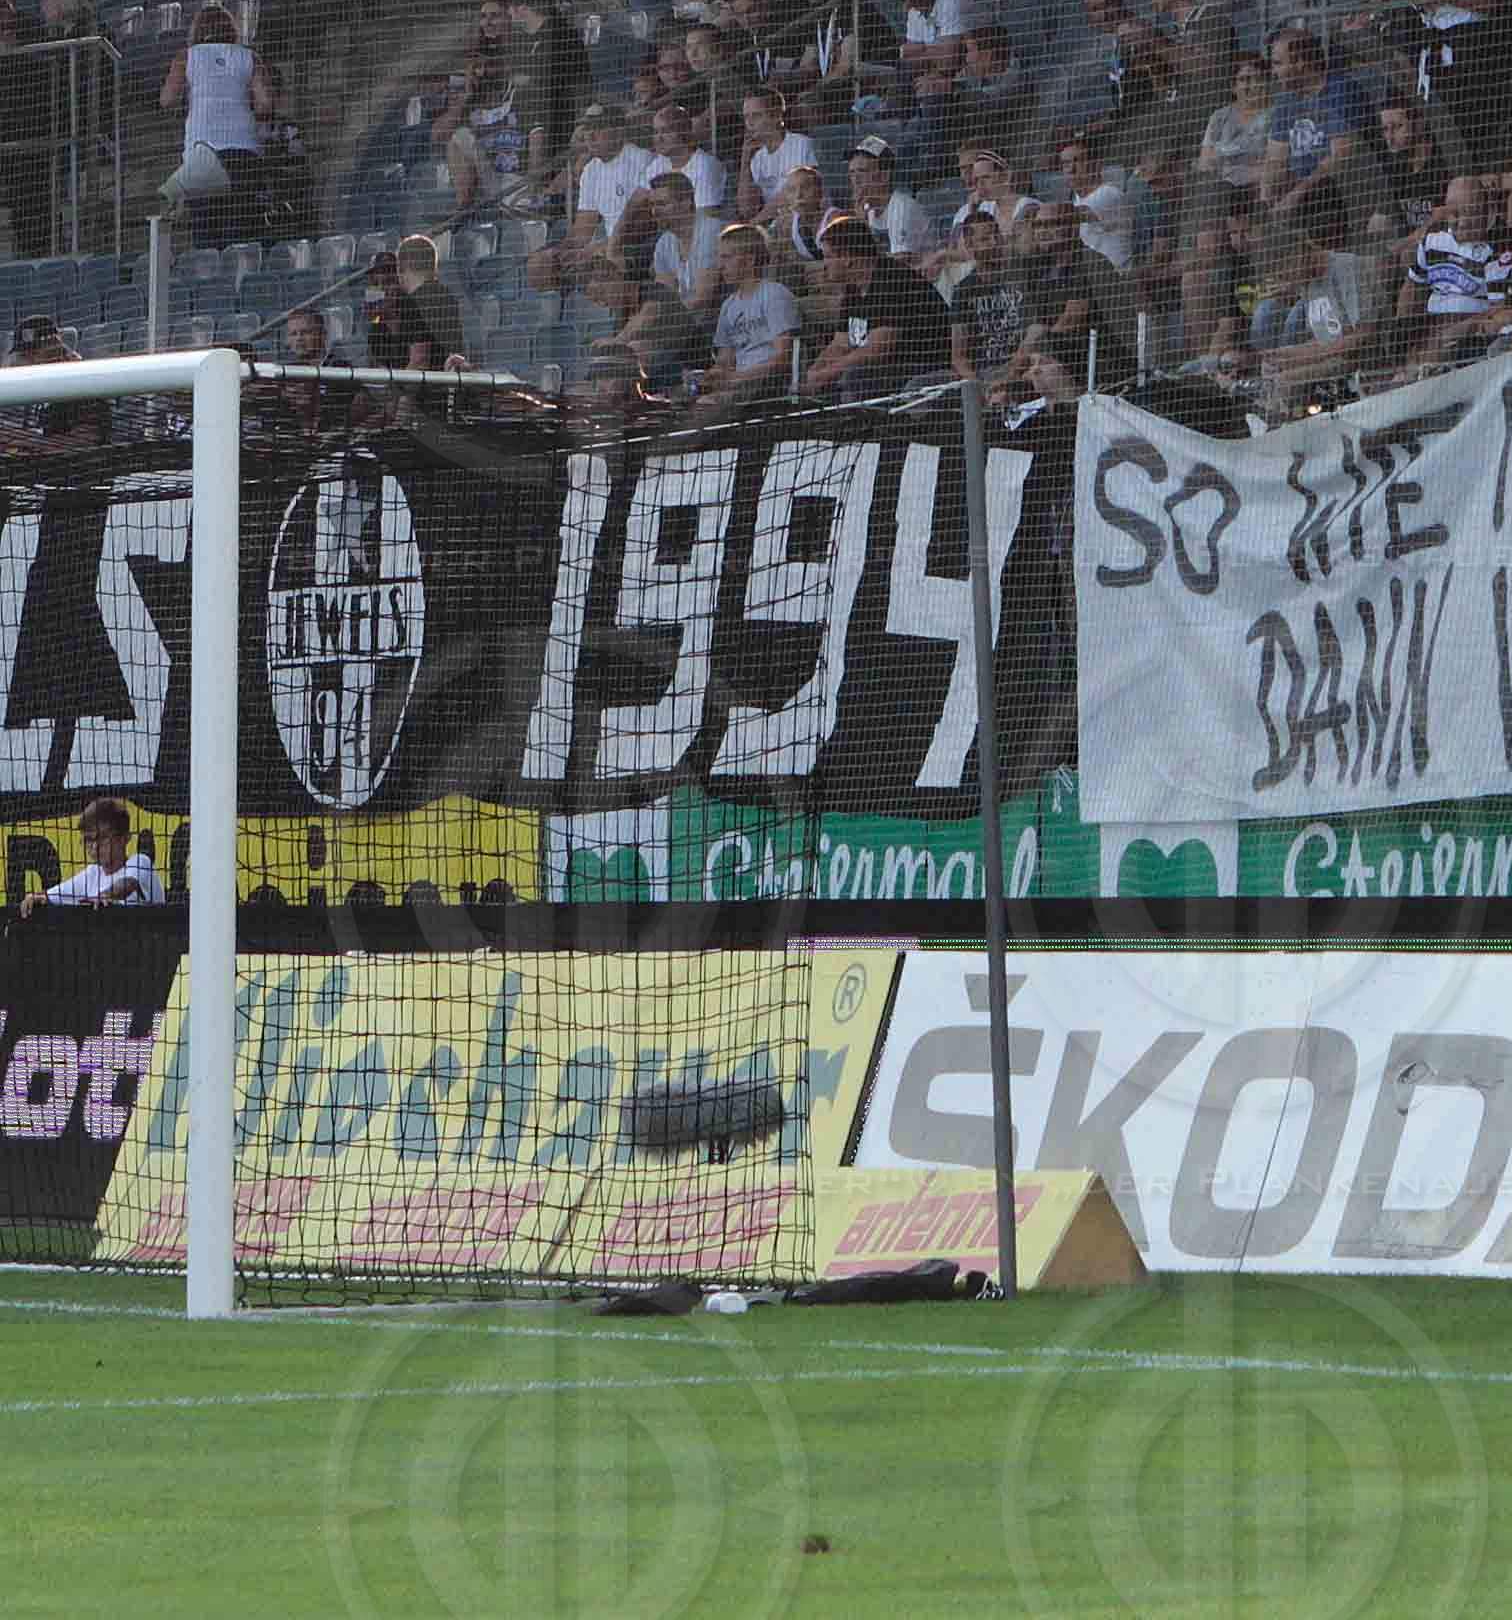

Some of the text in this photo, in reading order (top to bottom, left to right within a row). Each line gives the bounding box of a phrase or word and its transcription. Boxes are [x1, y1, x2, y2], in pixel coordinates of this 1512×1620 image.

[1092, 436, 1241, 595] SO
[1288, 401, 1473, 582] WIE
[522, 441, 1035, 787] 1994
[1246, 562, 1456, 792] DANN
